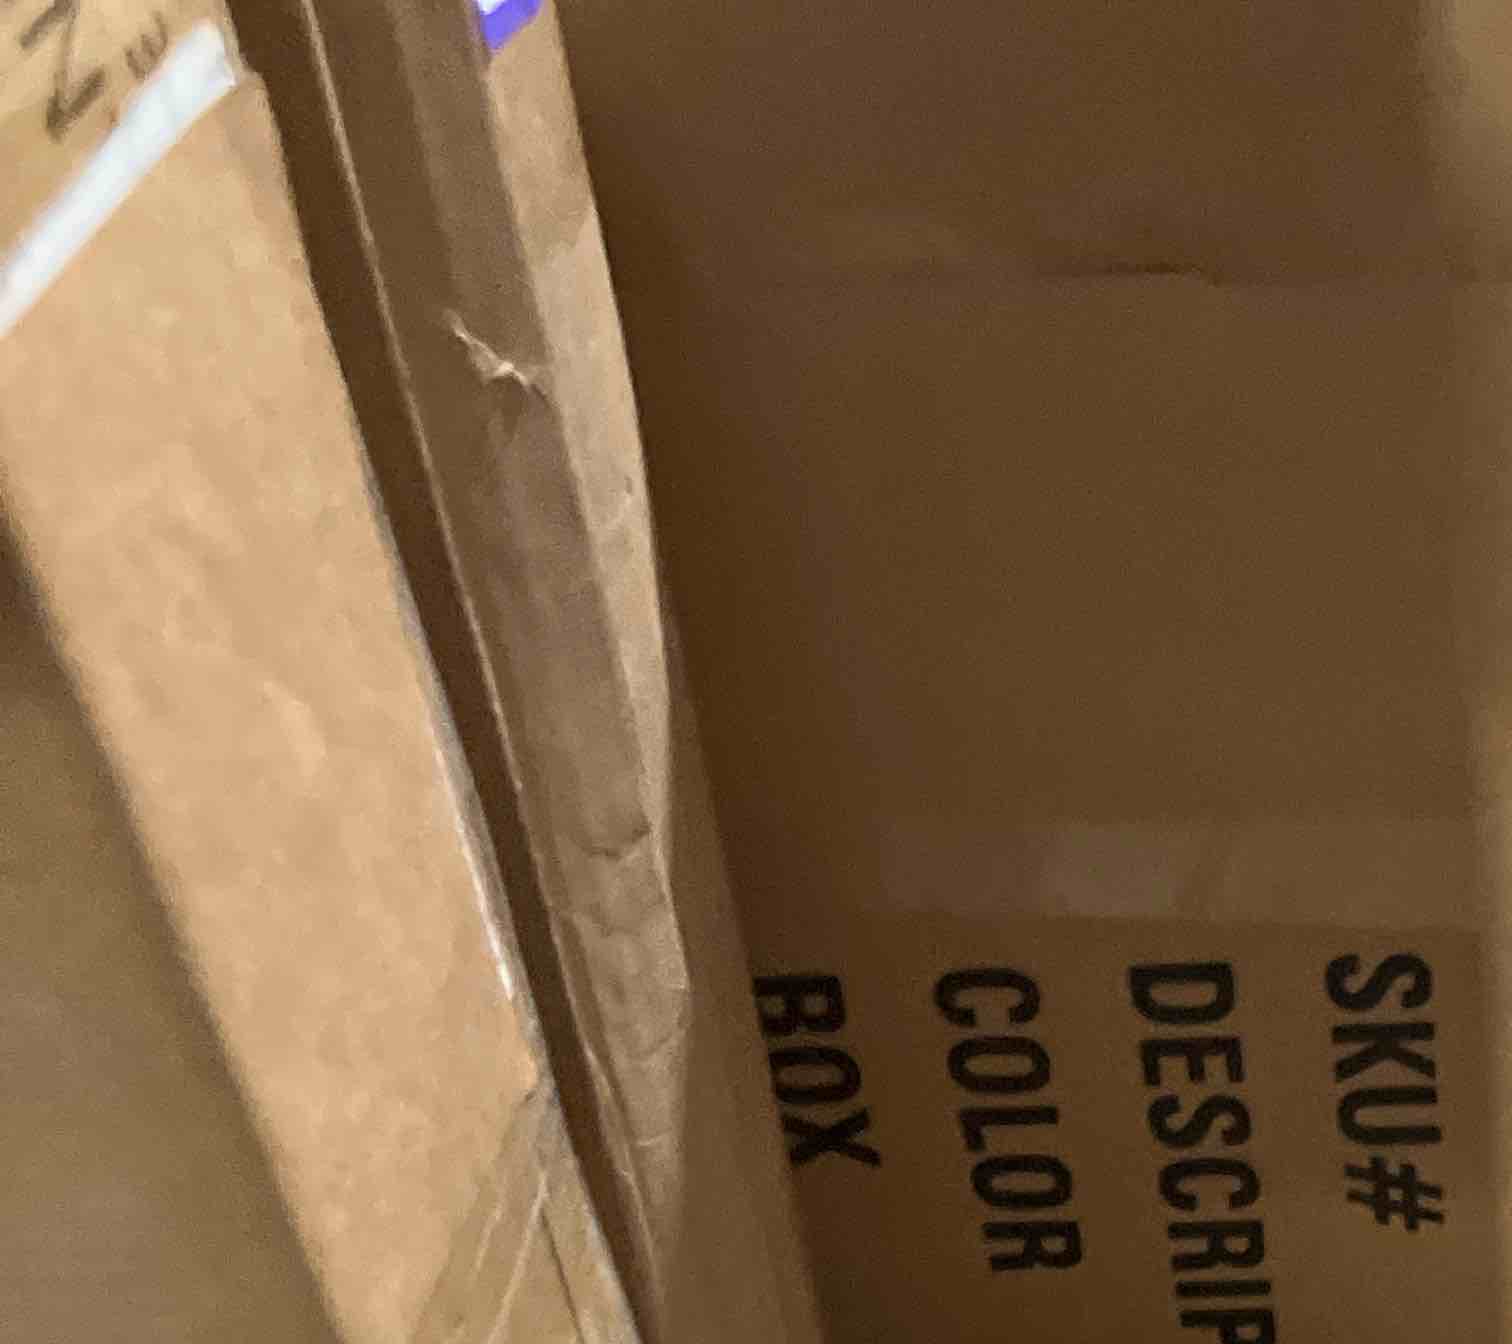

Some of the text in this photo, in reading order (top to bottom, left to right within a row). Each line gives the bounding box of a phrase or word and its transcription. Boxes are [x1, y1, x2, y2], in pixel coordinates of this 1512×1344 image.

[753, 974, 882, 1167] BOX
[931, 965, 1083, 1273] COLOR
[1322, 951, 1446, 1233] SKU#
